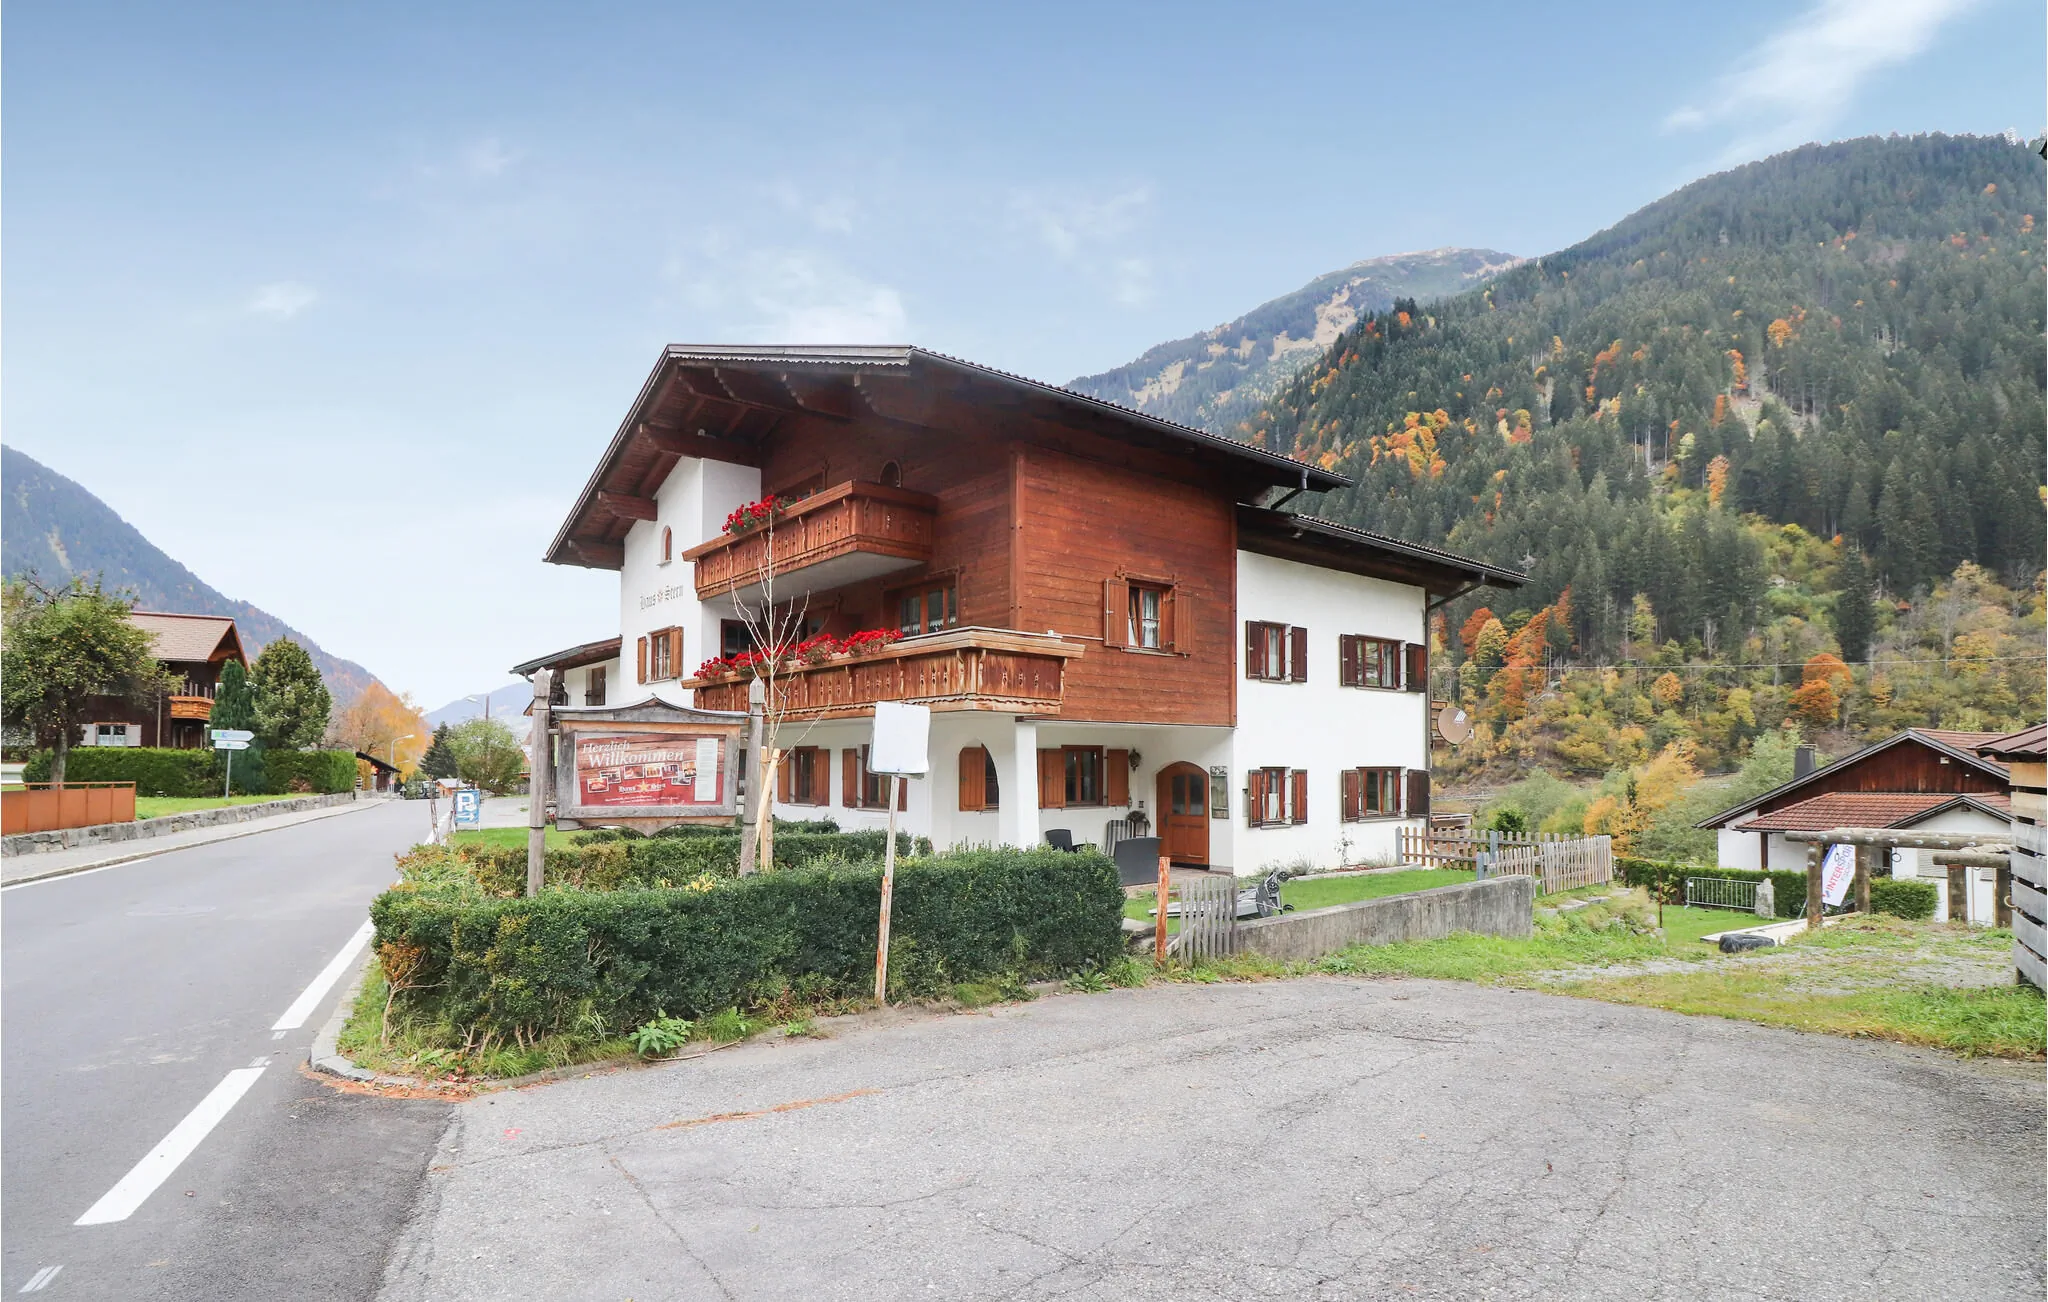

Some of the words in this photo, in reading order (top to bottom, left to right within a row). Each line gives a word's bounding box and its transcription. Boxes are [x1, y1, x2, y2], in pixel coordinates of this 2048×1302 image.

[582, 740, 630, 754] Herzlich
[588, 750, 684, 768] Willkommen
[1826, 844, 1854, 891] INTERSPOR
